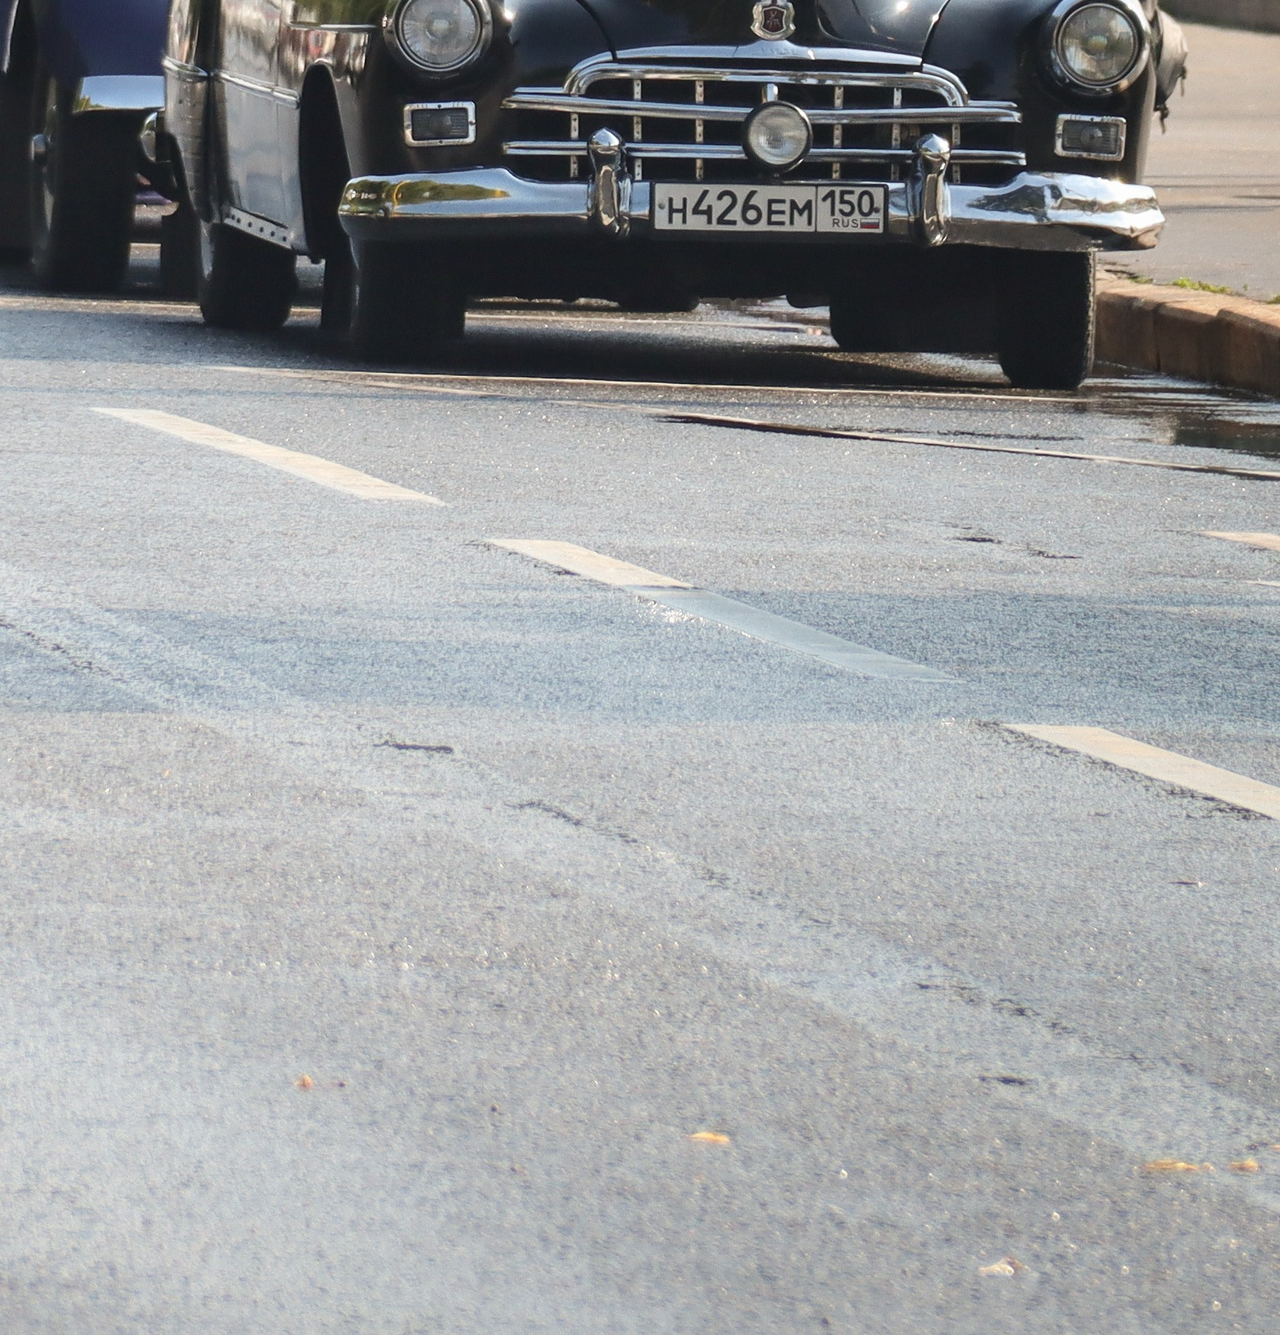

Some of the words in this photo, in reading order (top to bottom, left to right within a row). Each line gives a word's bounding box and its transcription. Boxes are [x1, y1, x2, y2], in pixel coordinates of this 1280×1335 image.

[668, 189, 813, 226] Н426ЕМ
[822, 190, 875, 217] 150
[832, 218, 859, 229] RUS
